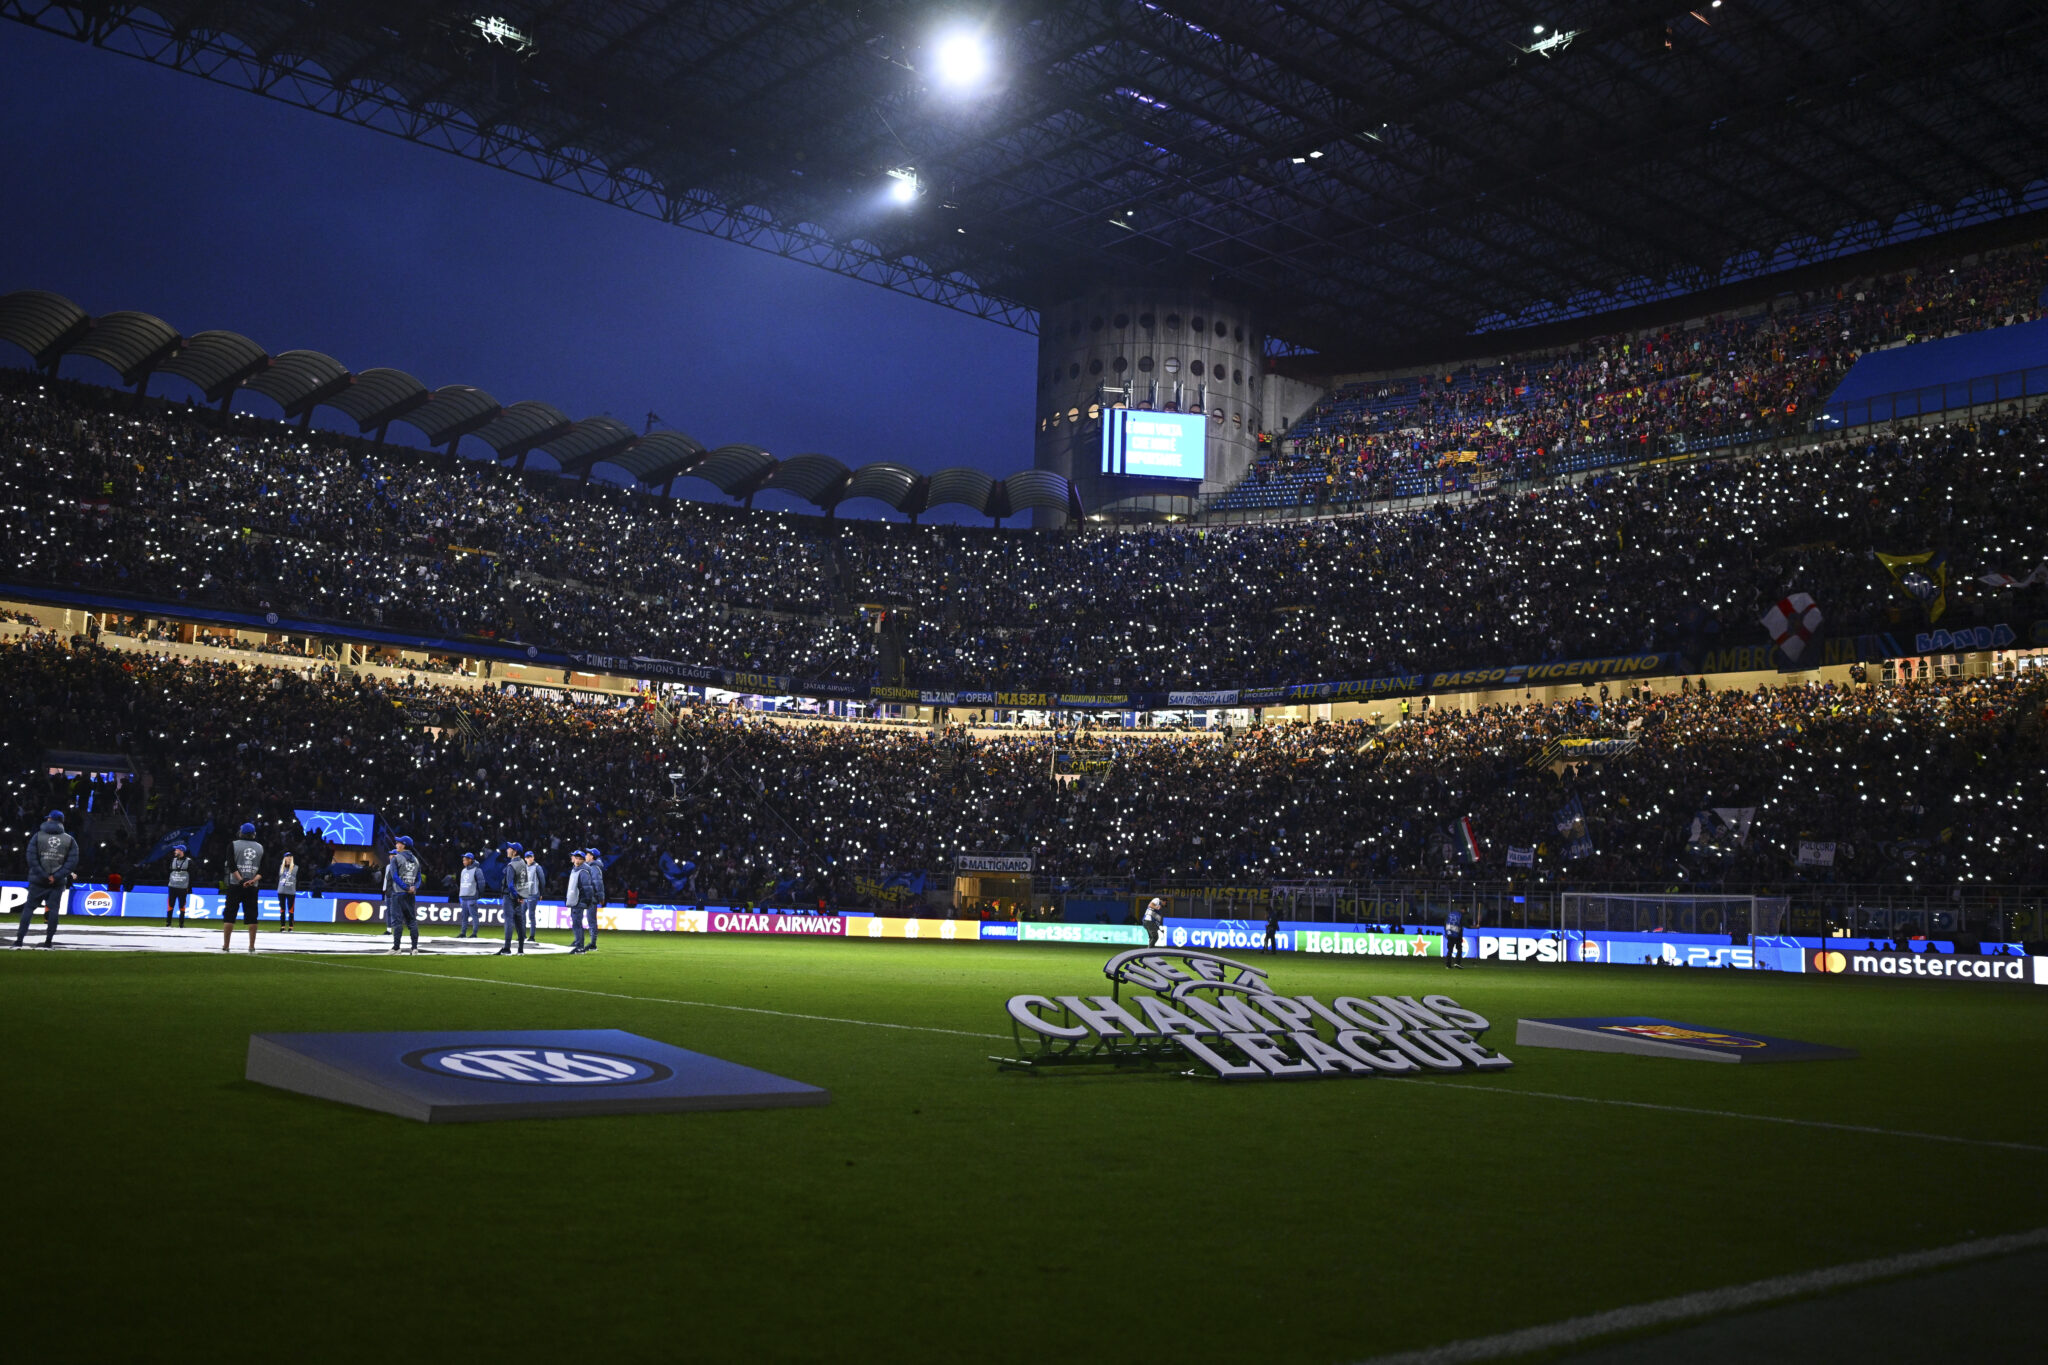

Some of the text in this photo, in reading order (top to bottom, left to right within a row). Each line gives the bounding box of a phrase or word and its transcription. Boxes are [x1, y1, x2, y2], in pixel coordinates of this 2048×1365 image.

[1916, 623, 2017, 653] BANDA
[1703, 639, 1857, 672] AMBRONA
[677, 664, 712, 680] LEAGUE
[735, 672, 777, 689] MOLE
[1432, 656, 1659, 687] BASSO VICENTINO
[803, 682, 826, 692] QATAR
[871, 686, 920, 700] FROSINONE
[1336, 674, 1418, 697] POLESINE
[921, 691, 956, 704] BOLZANO
[966, 691, 993, 704] OPERA
[998, 692, 1048, 707] MASSA
[1168, 695, 1185, 705] SAN
[1186, 695, 1215, 705] GIORGIO
[968, 859, 1028, 870] MALTIGNANO
[87, 900, 111, 908] PEPSI
[1203, 886, 1272, 902] MESTRE
[642, 909, 699, 932] FedEx
[714, 914, 841, 935] QATAR AIRWAYS
[1025, 925, 1082, 941] bet365
[1306, 931, 1409, 957] Heineken
[1479, 936, 1567, 962] PEPSI
[1688, 948, 1758, 969] PS5
[1852, 955, 2025, 980] mastercard
[1122, 956, 1276, 997] UEFA
[1006, 994, 1490, 1038] CHAMPIONS
[1170, 1030, 1514, 1078] LEAGUE
